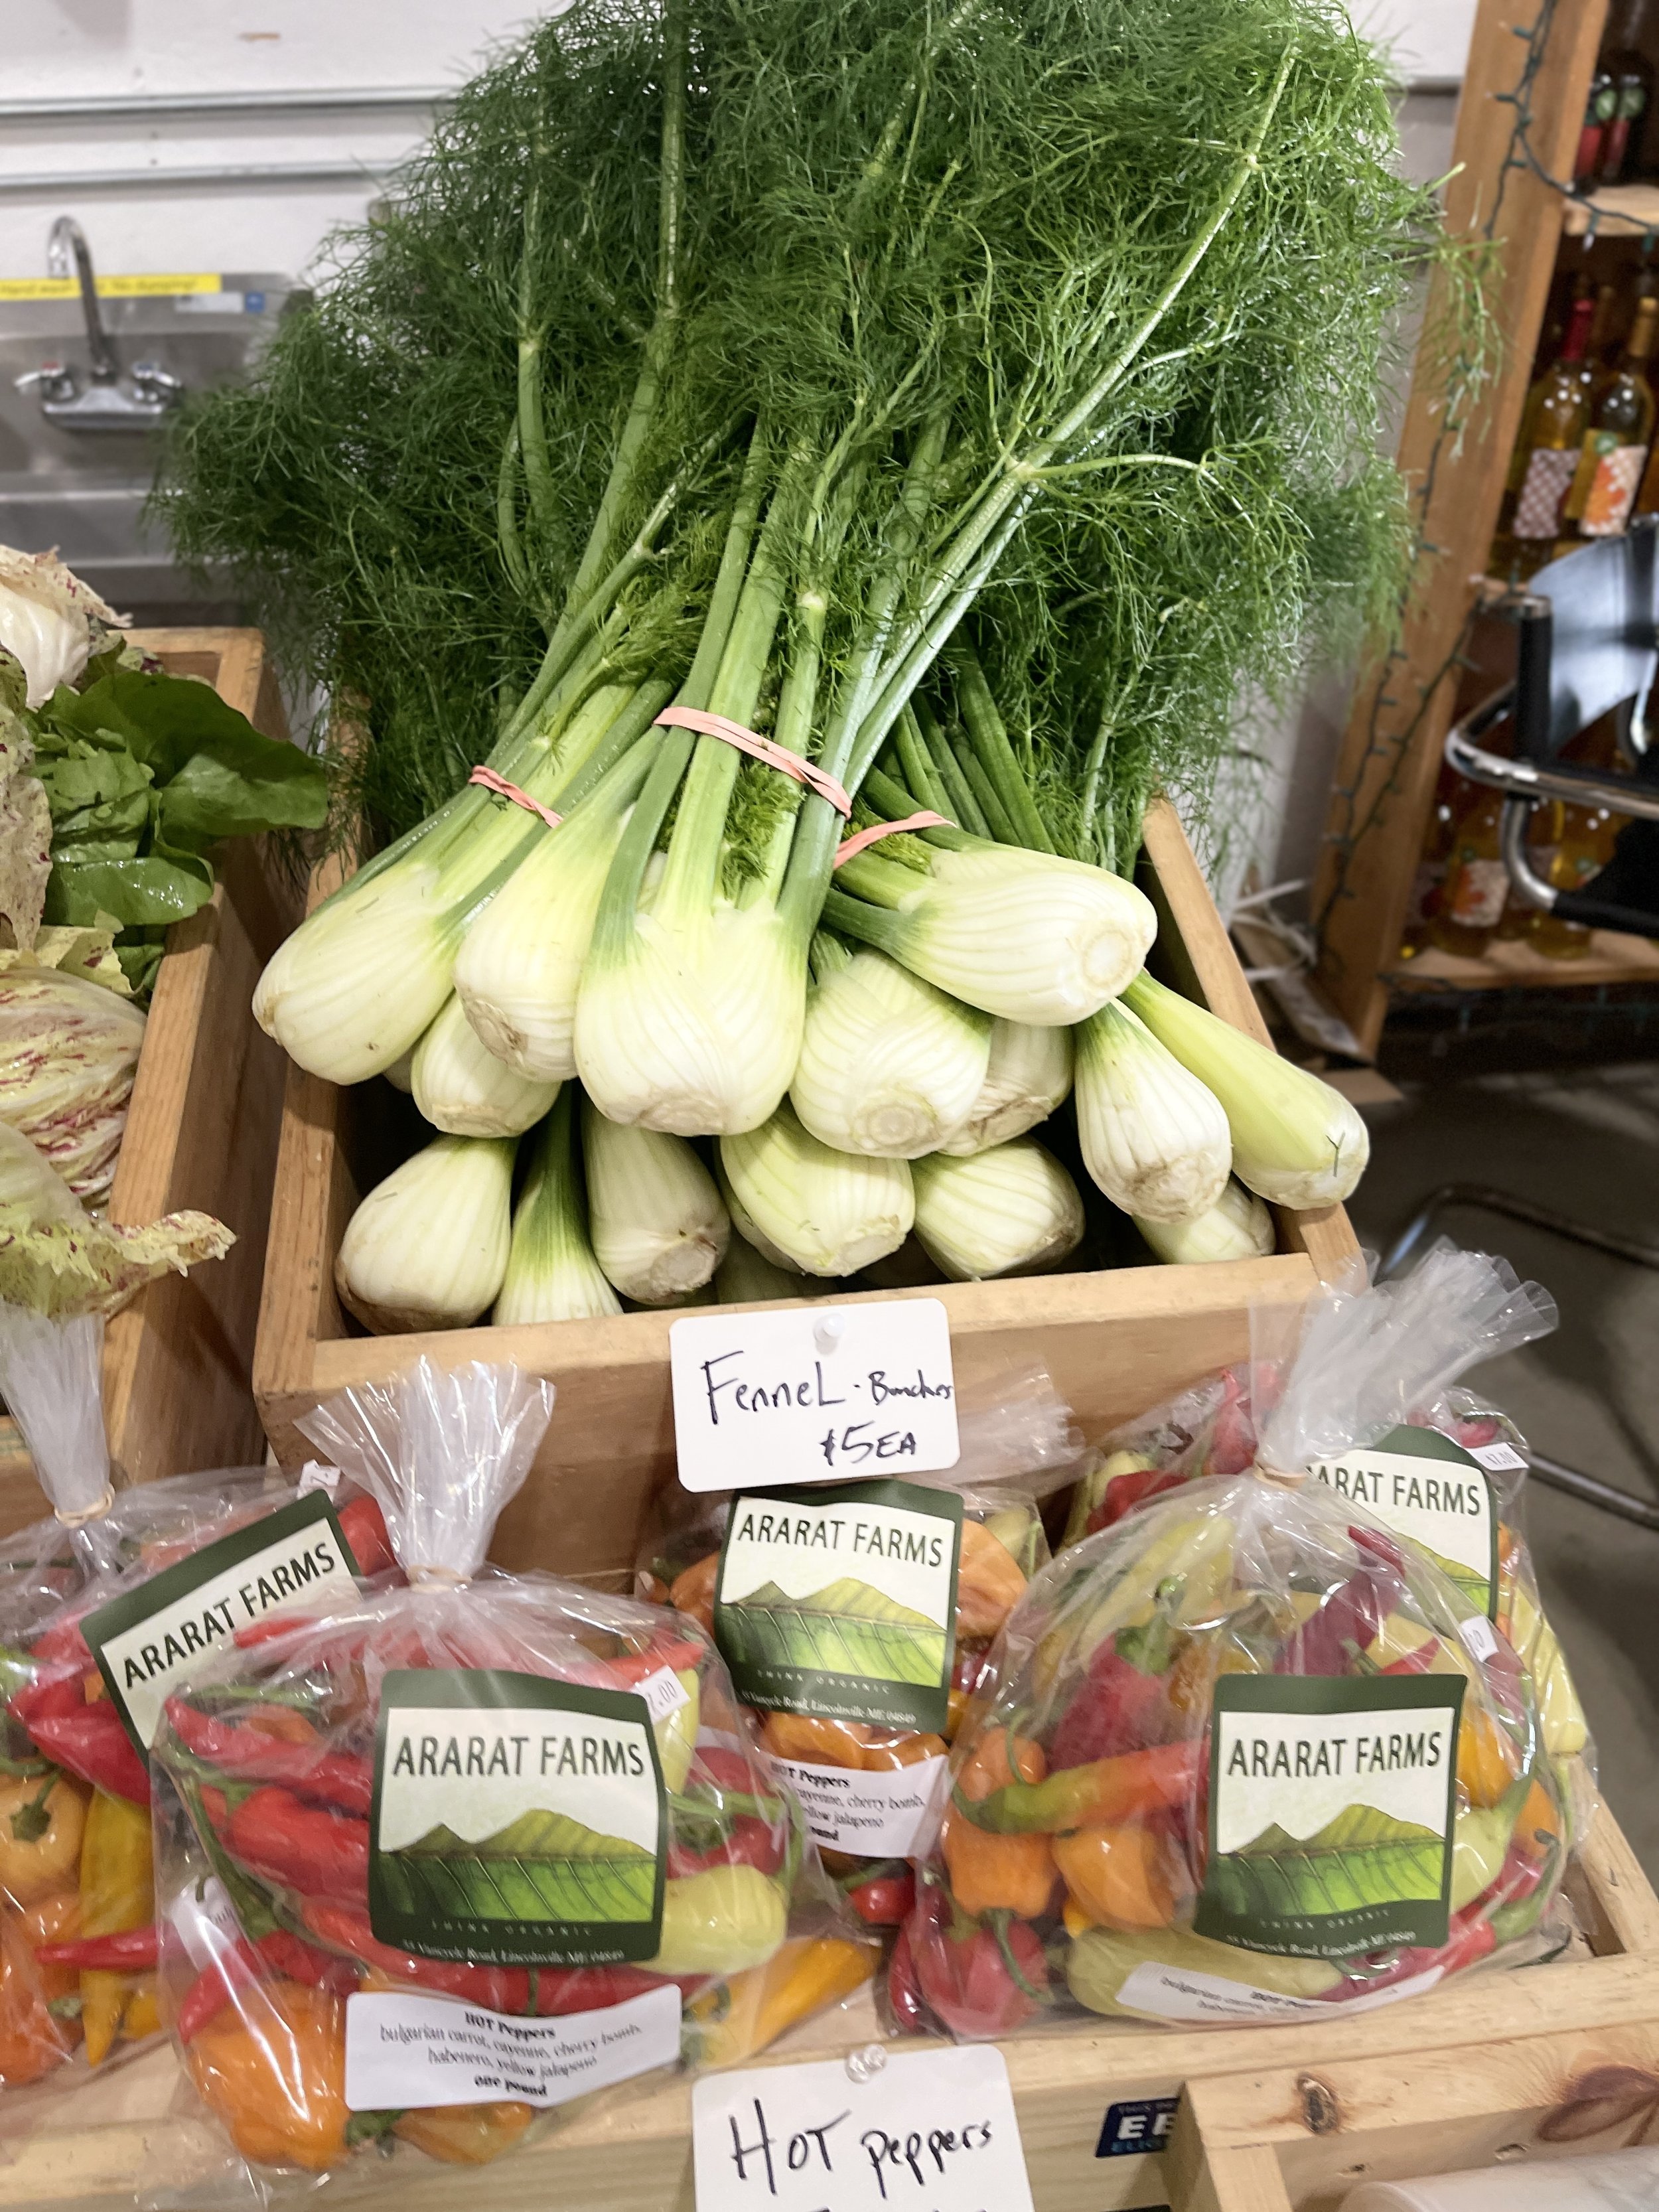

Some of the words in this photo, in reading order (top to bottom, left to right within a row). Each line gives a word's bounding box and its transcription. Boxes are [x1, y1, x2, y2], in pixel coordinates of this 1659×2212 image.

[1393, 1474, 1480, 1516] FARMS
[737, 1514, 846, 1550] ARARAT
[853, 1524, 942, 1567] FARMS
[123, 1597, 236, 1689] ARARAT
[238, 1543, 335, 1617] FARMS
[816, 1676, 889, 1694] ORGANIC
[393, 1735, 530, 1777] ARARAT
[540, 1735, 644, 1776] FARMS
[1228, 1739, 1347, 1777] ARARAT
[1355, 1732, 1441, 1773] FARMS
[799, 1769, 851, 1789] Peppers
[465, 2011, 494, 2031] HOT
[498, 2020, 556, 2042] Peppers
[474, 2075, 502, 2087] one
[505, 2078, 547, 2097] pound
[861, 2119, 991, 2199] peppers
